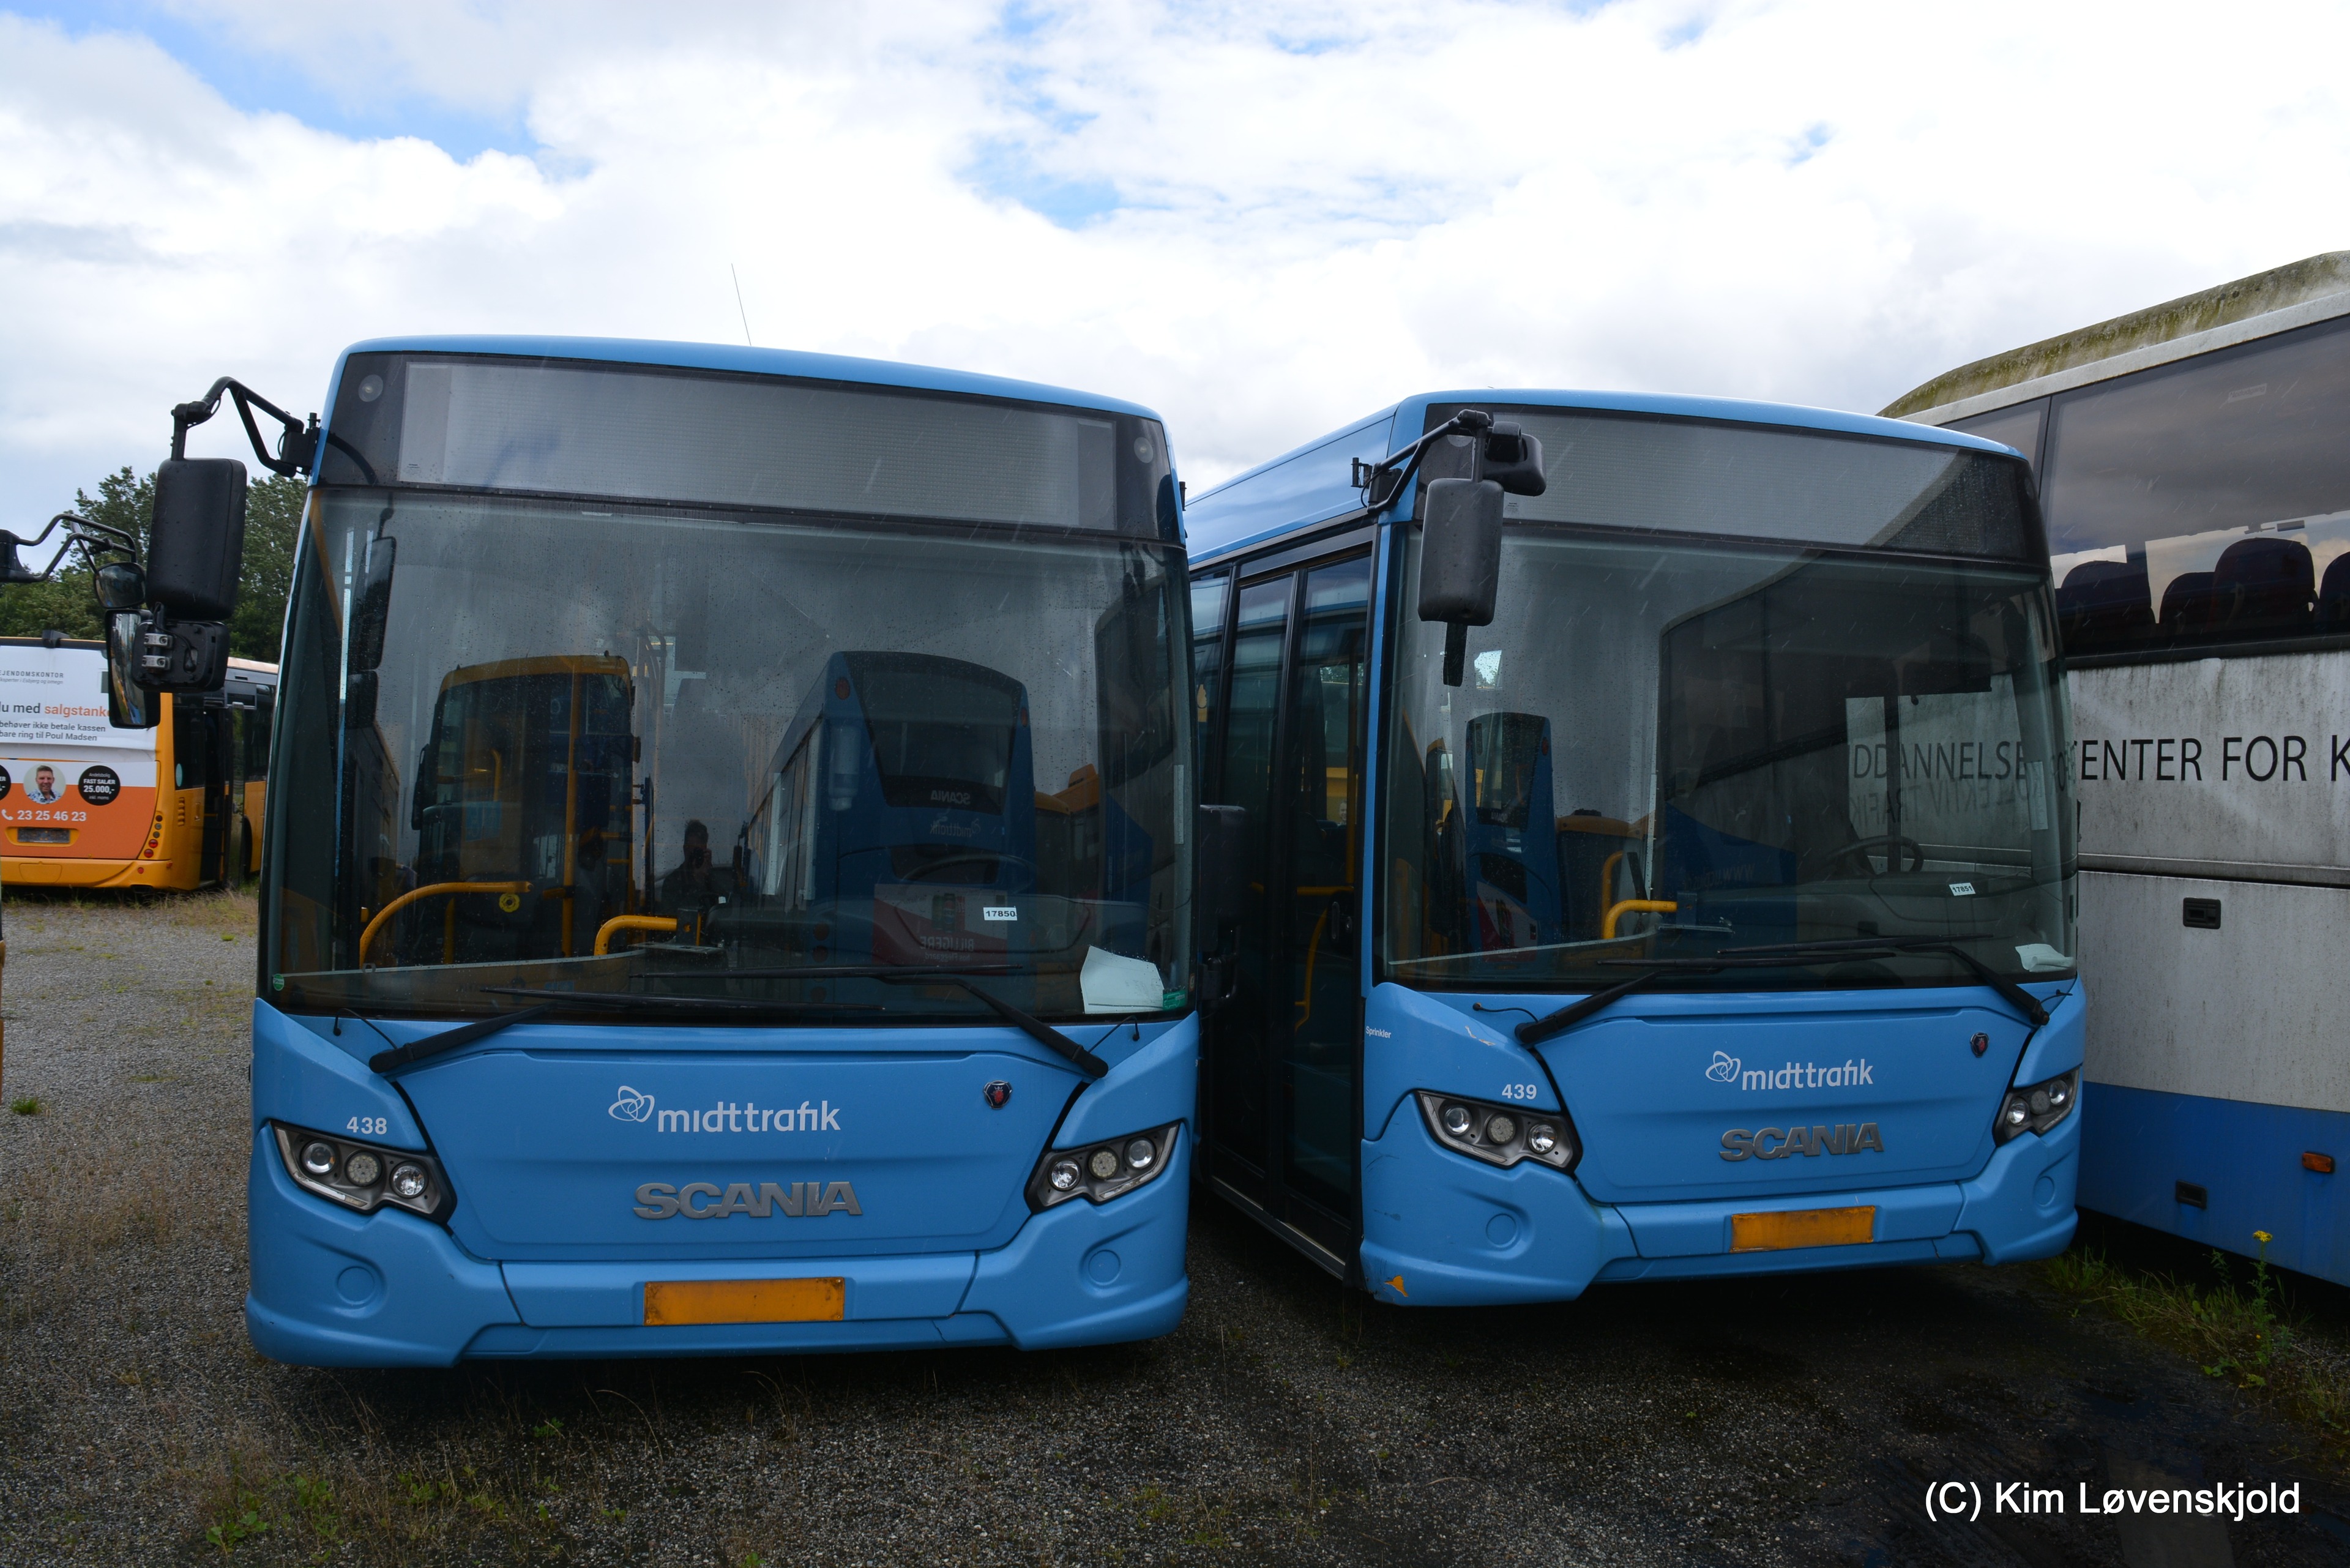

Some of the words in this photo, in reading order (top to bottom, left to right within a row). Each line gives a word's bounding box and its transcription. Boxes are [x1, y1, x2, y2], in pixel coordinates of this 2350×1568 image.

[0, 701, 9, 712] u
[13, 703, 40, 714] med
[45, 704, 110, 717] salgstank
[18, 731, 33, 739] ring
[65, 733, 97, 741] Madsen
[2222, 736, 2307, 782] FOR
[83, 785, 115, 794] 25.000,-
[17, 810, 32, 820] 23
[35, 810, 51, 821] 25
[53, 811, 69, 821] 46
[72, 812, 87, 821] 23
[1365, 1026, 1392, 1039] Sprinkler
[1742, 1059, 1874, 1090] midttrafik
[1501, 1083, 1537, 1100] 439
[346, 1116, 387, 1135] 438
[658, 1100, 841, 1133] midttrafik
[1719, 1122, 1885, 1162] SCANIA
[633, 1181, 862, 1220] SCANIA
